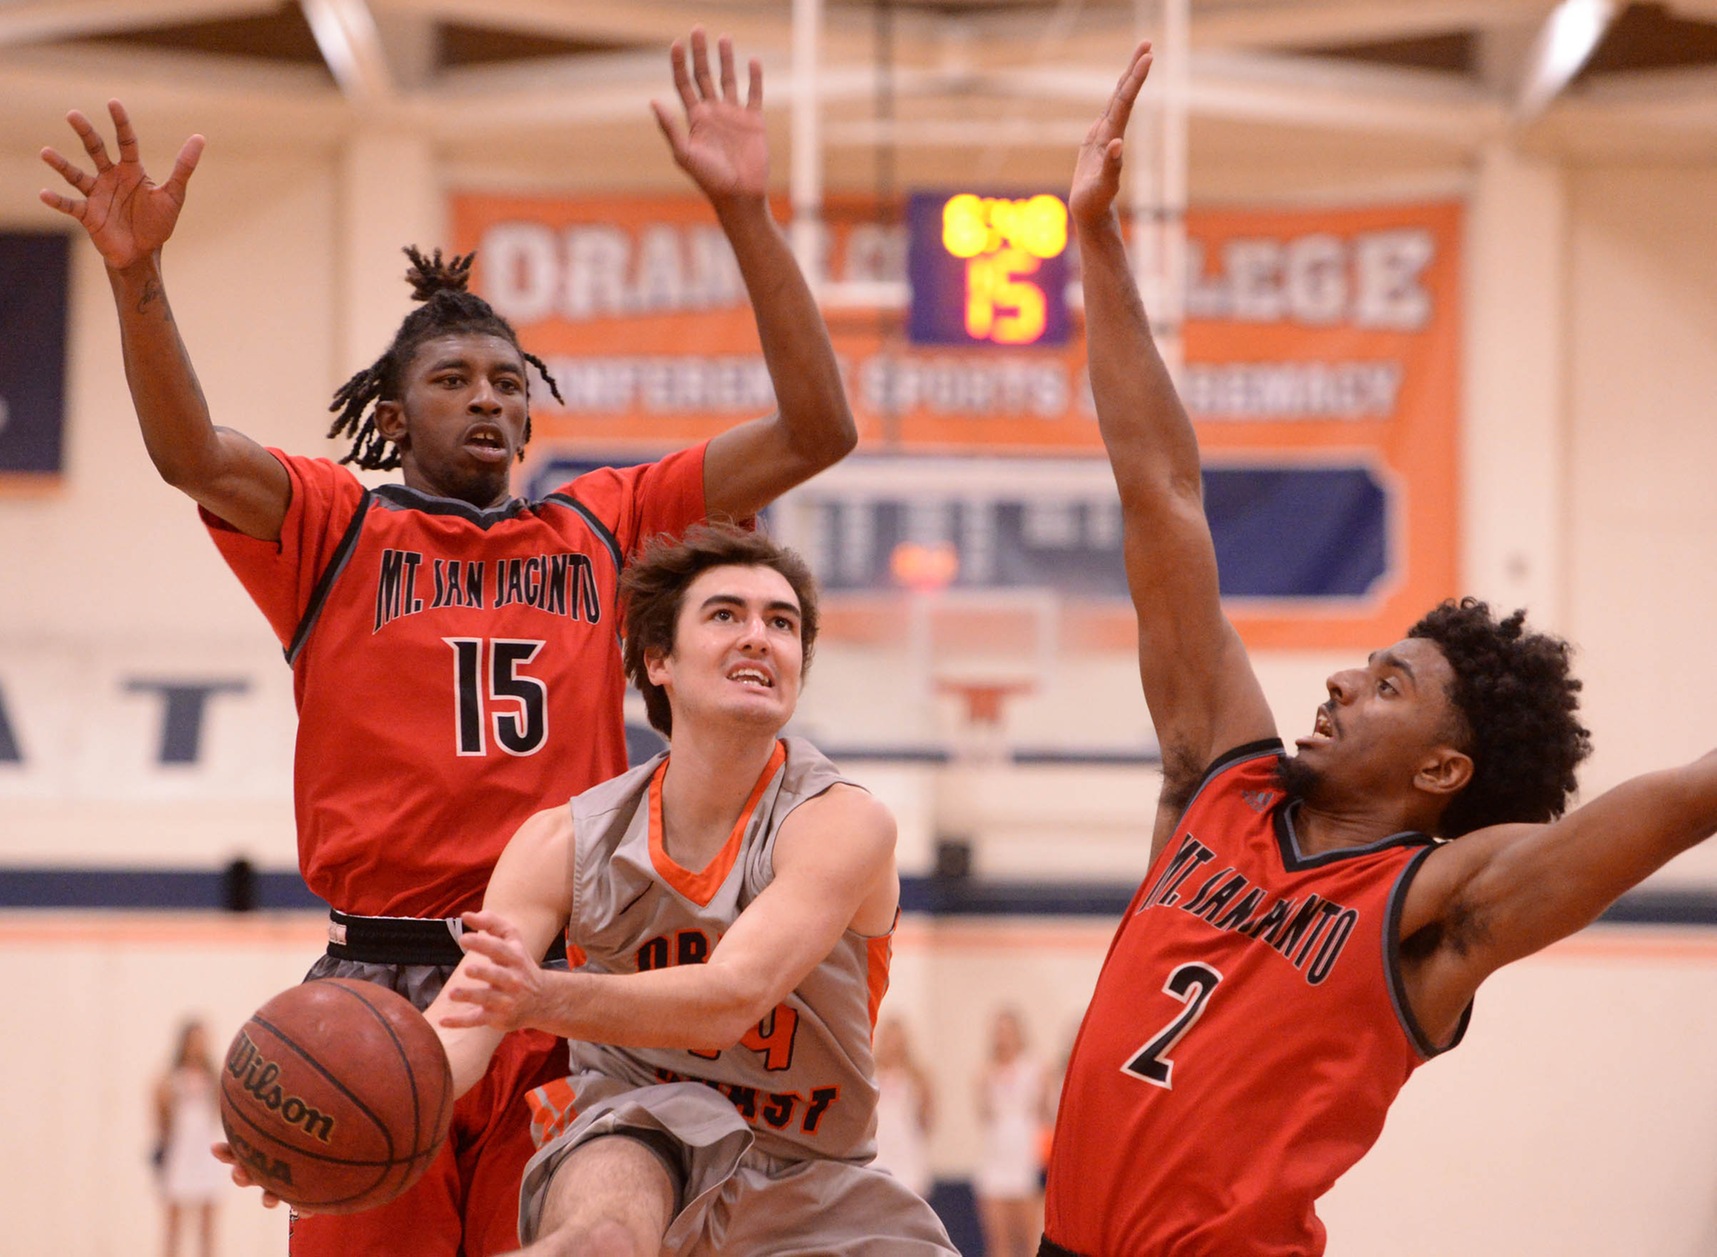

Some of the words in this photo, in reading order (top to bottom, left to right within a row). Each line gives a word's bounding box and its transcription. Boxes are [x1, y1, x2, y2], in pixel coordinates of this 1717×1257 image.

[965, 252, 1046, 344] 15
[372, 548, 424, 635] MT.
[429, 558, 485, 611] SAN
[492, 553, 602, 625] JACINTO
[440, 636, 550, 757] 15
[1178, 866, 1268, 933] SAN
[1119, 960, 1225, 1091] 2
[226, 1030, 335, 1146] Wilson
